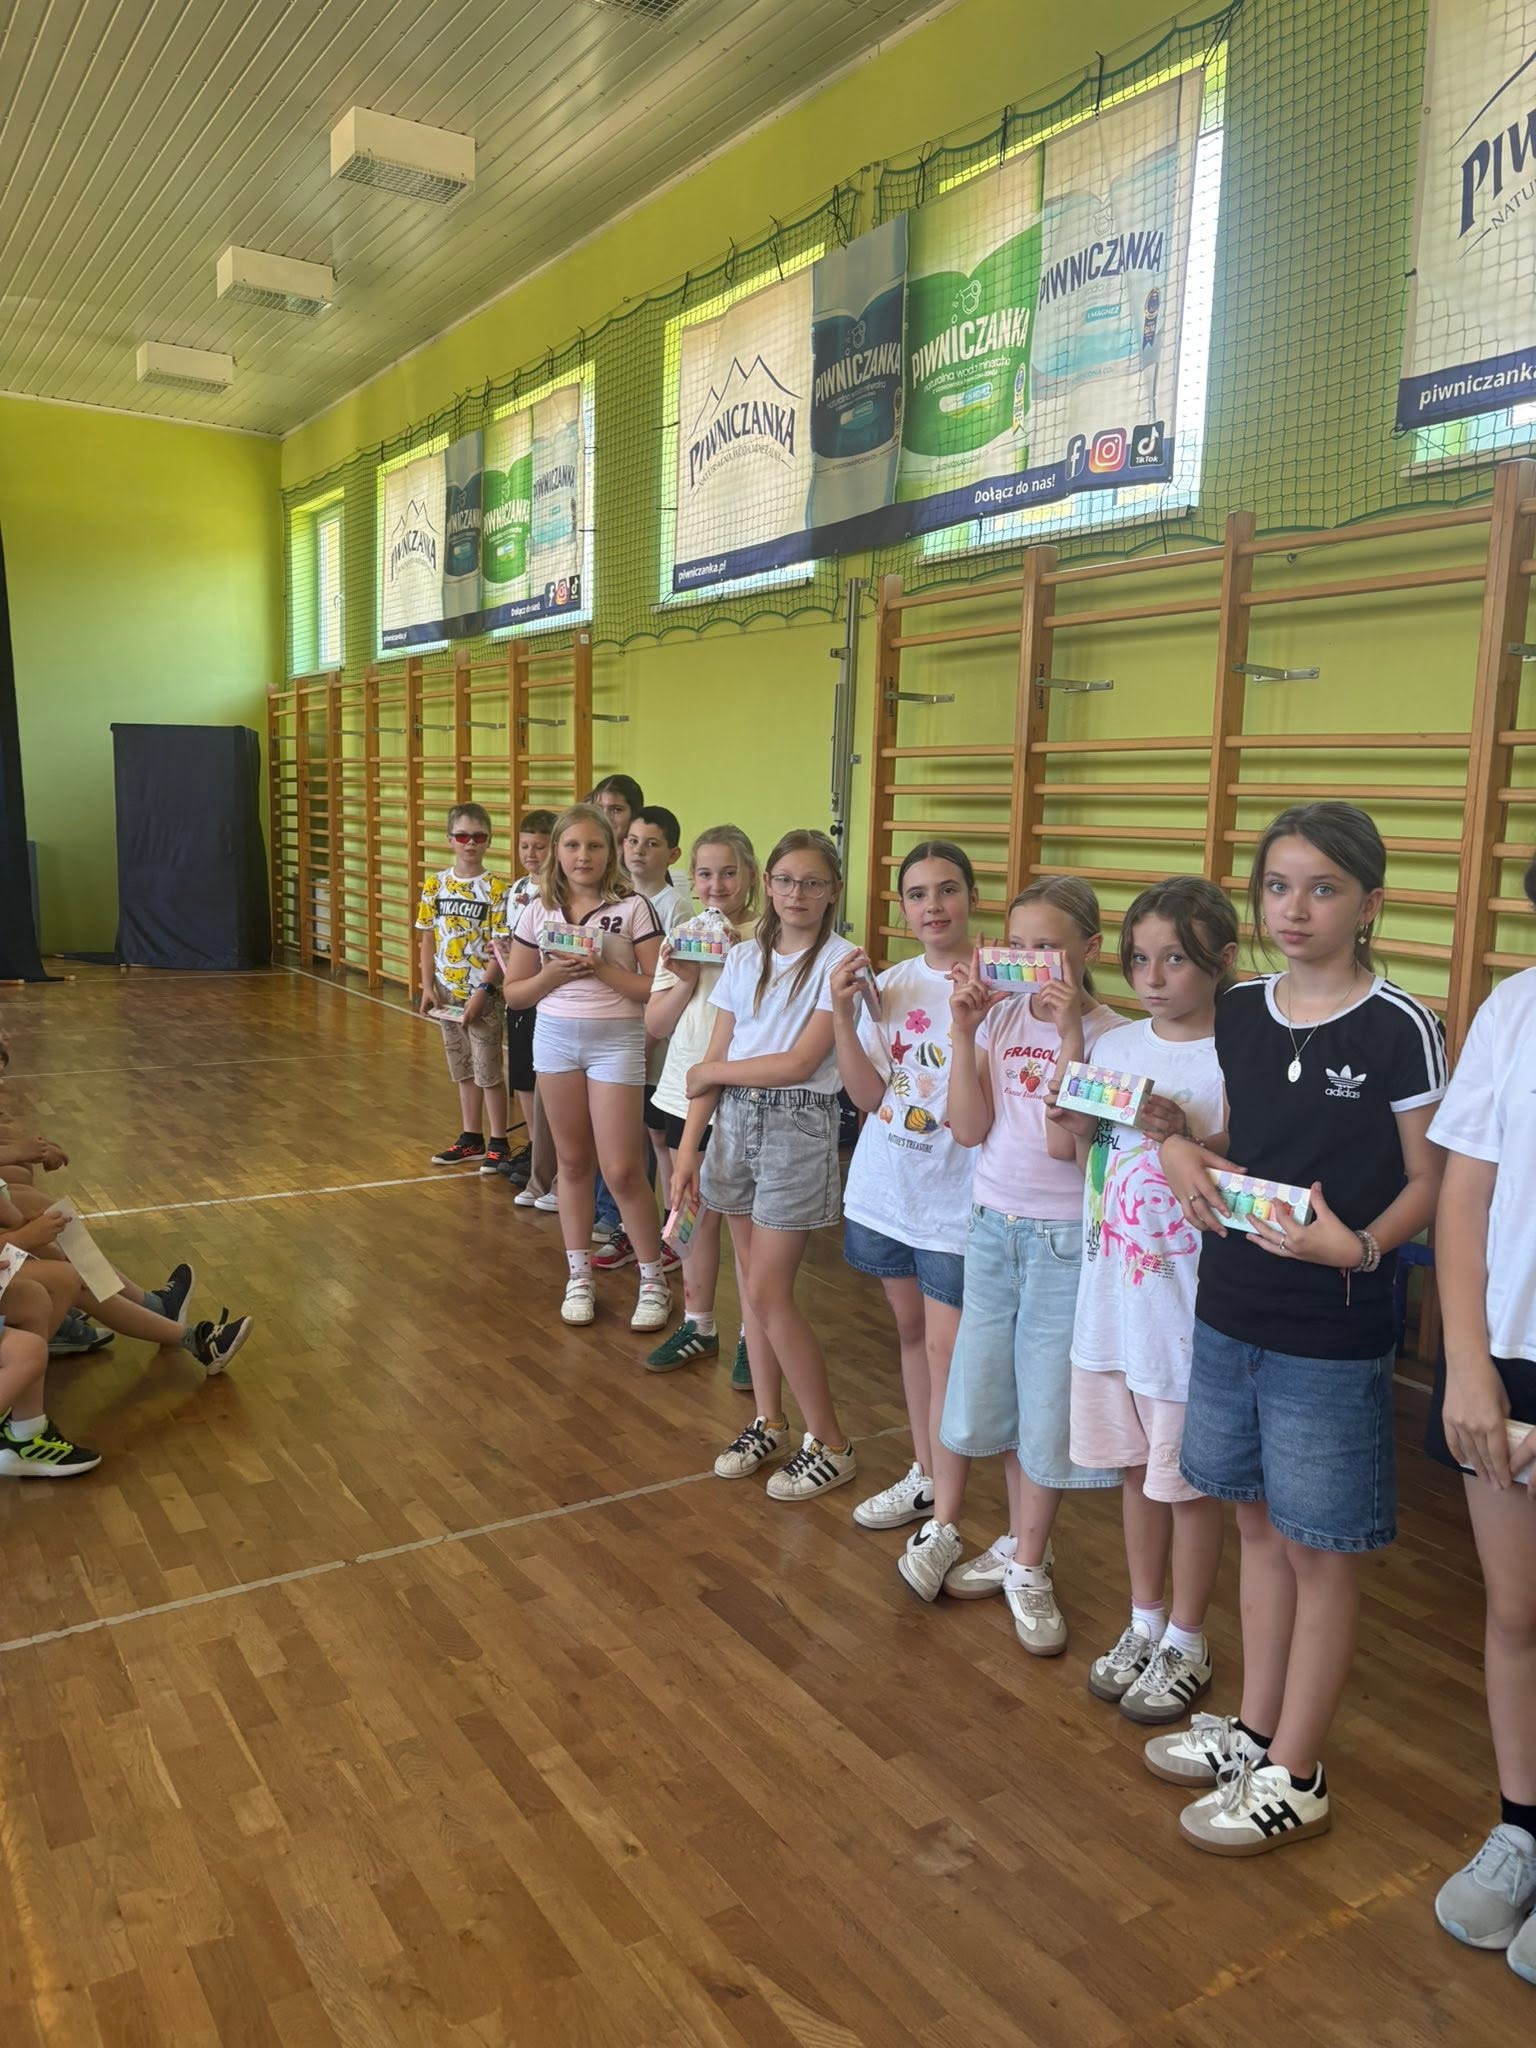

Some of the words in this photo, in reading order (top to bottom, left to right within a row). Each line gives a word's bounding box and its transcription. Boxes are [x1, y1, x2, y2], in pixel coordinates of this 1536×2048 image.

[1039, 231, 1164, 311] PIWNICZANKA
[912, 307, 1031, 389] PIWNICZANKA
[815, 342, 901, 407] PIWNICZANKA
[689, 401, 796, 489] PIWNICZANKA
[1135, 456, 1159, 464] TikTok
[974, 485, 1014, 504] Dołącz
[1015, 481, 1028, 495] do
[1032, 473, 1057, 491] nas!
[678, 560, 727, 583] piwniczanka.pl
[439, 901, 483, 918] PIKACHU
[599, 916, 623, 933] 92
[1325, 1087, 1360, 1099] adidas
